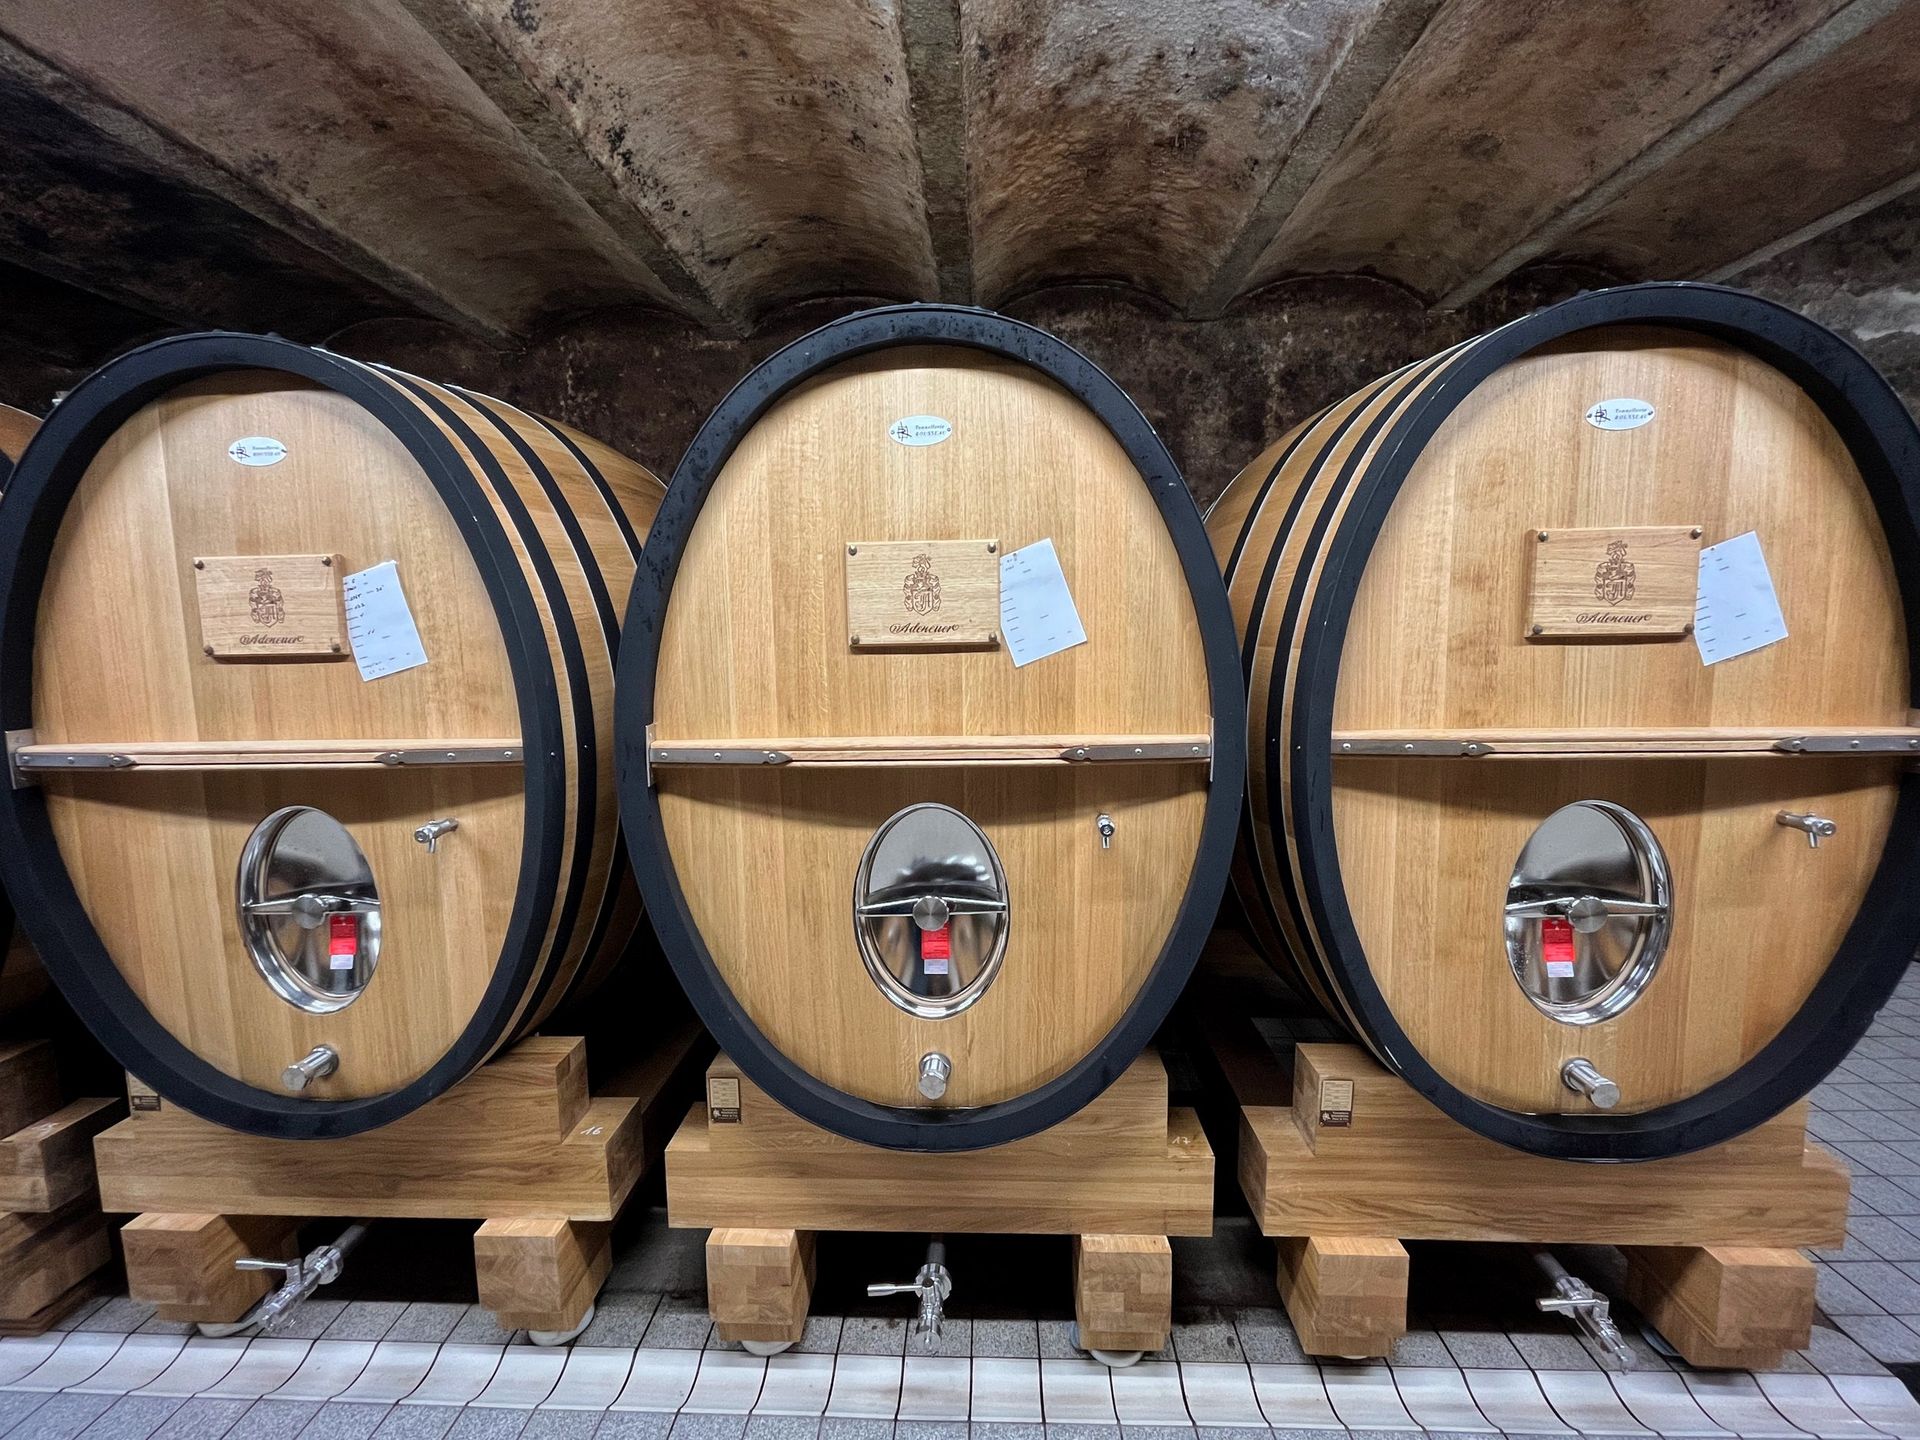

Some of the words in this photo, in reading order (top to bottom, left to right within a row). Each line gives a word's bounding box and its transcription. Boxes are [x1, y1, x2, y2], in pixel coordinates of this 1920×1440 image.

[1576, 612, 1652, 624] Adeneuer
[889, 622, 960, 634] Adeneuer
[239, 634, 304, 645] Adeneuer
[580, 1126, 603, 1135] 16
[1172, 1136, 1191, 1145] 17
